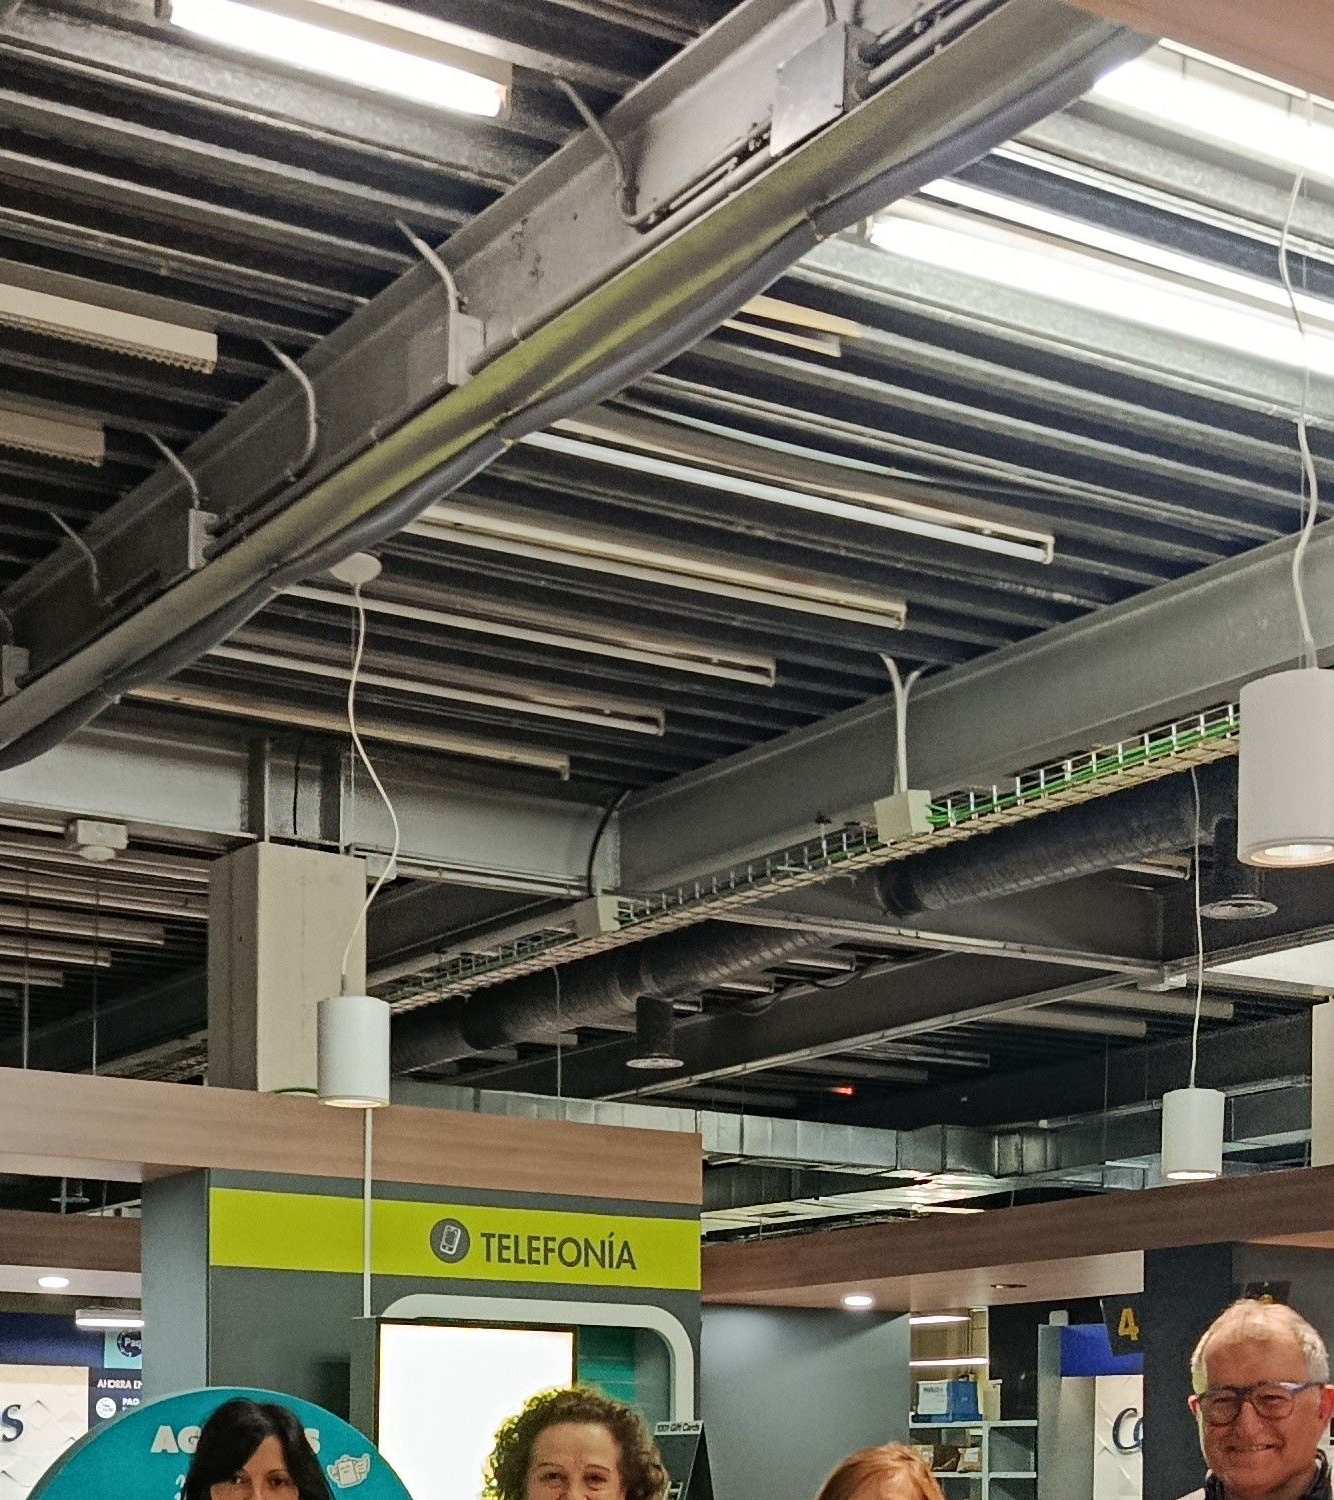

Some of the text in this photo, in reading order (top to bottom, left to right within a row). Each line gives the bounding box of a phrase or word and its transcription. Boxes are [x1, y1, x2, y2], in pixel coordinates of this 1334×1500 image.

[481, 1231, 636, 1270] TELEFONÍA
[1118, 1307, 1139, 1341] 4
[97, 1379, 132, 1389] AHORRA
